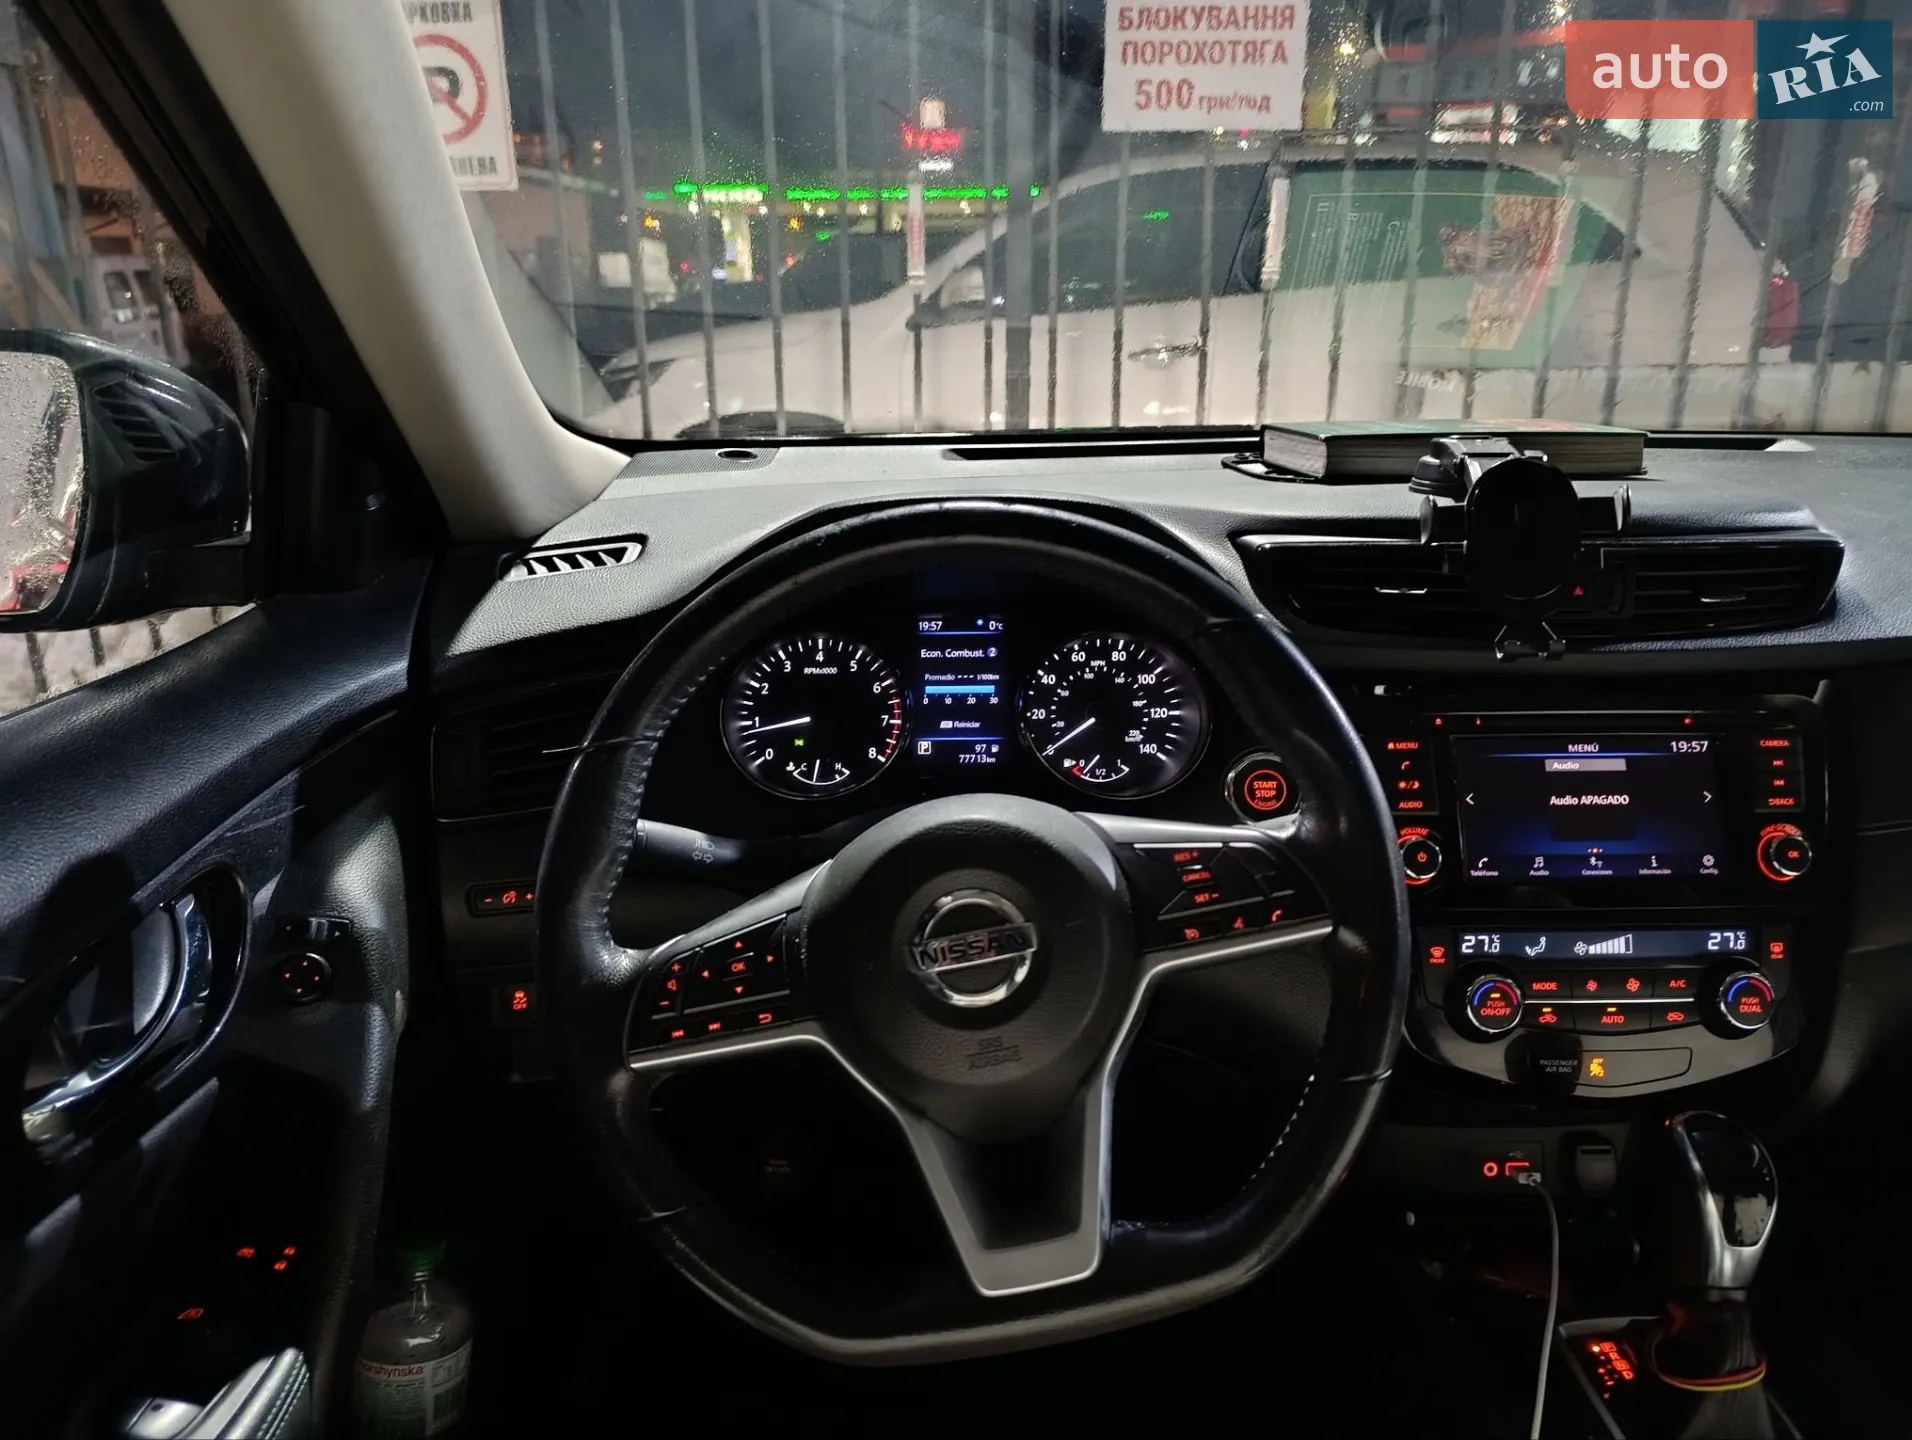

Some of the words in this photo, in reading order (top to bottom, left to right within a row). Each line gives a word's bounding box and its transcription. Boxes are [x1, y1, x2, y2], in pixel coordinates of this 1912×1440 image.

[1118, 5, 1295, 32] БЛОКУВАННЯ
[1121, 40, 1288, 65] ПОРОХОТЯГА
[1135, 78, 1195, 112] 500
[918, 620, 943, 631] 19:57
[815, 651, 824, 662] 4
[920, 649, 944, 658] Econ.
[945, 649, 985, 658] Combust.
[1071, 651, 1086, 662] 60
[1111, 651, 1126, 662] 80
[783, 661, 792, 673] 3
[849, 660, 858, 672] 5
[1041, 674, 1056, 685] 40
[1137, 674, 1156, 685] 100
[761, 683, 769, 695] 2
[872, 682, 882, 694] 6
[967, 697, 976, 705] 20
[989, 697, 999, 705] 30
[1031, 709, 1046, 720] 20
[1150, 708, 1168, 719] 120
[754, 716, 760, 728] 1
[881, 715, 889, 727] 7
[975, 744, 986, 753] 97
[1139, 743, 1157, 755] 140
[1568, 742, 1599, 753] MENÚ
[1670, 740, 1709, 753] 19:57
[765, 748, 774, 760] 0
[868, 747, 877, 759] 8
[1552, 761, 1580, 770] Audio
[1253, 781, 1278, 789] START
[1255, 790, 1276, 798] STOP
[1399, 801, 1423, 809] AUDIO
[1550, 795, 1579, 806] Audio
[1580, 795, 1630, 805] APAGADO
[913, 931, 1027, 970] NISSAN
[1532, 982, 1558, 990] MODE
[1669, 979, 1687, 988] A/C
[1739, 1004, 1763, 1013] DUAL
[1601, 1016, 1625, 1024] AUTO
